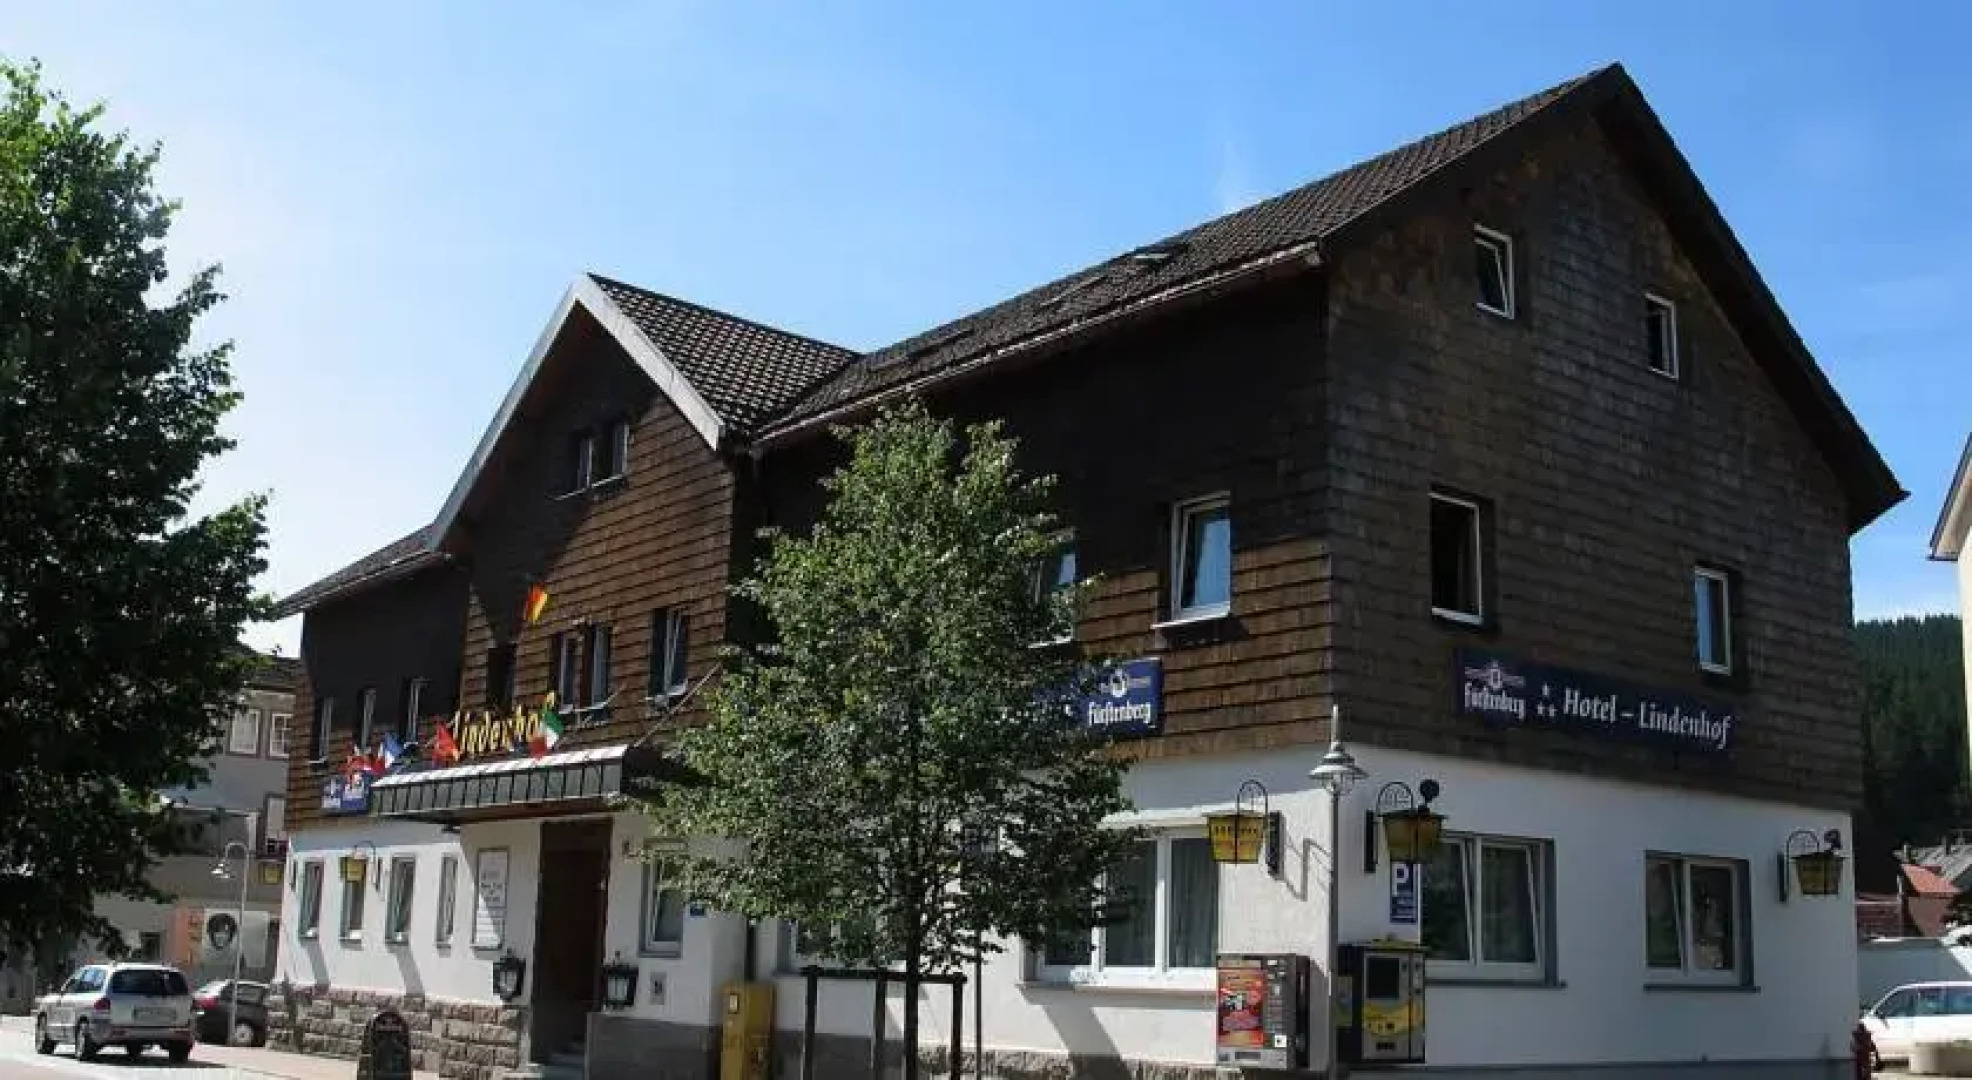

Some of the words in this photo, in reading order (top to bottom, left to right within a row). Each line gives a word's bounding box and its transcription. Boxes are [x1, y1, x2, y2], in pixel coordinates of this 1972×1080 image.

[1563, 688, 1618, 722] Hotel
[1638, 701, 1732, 749] Lindenhof
[1391, 862, 1410, 897] P
